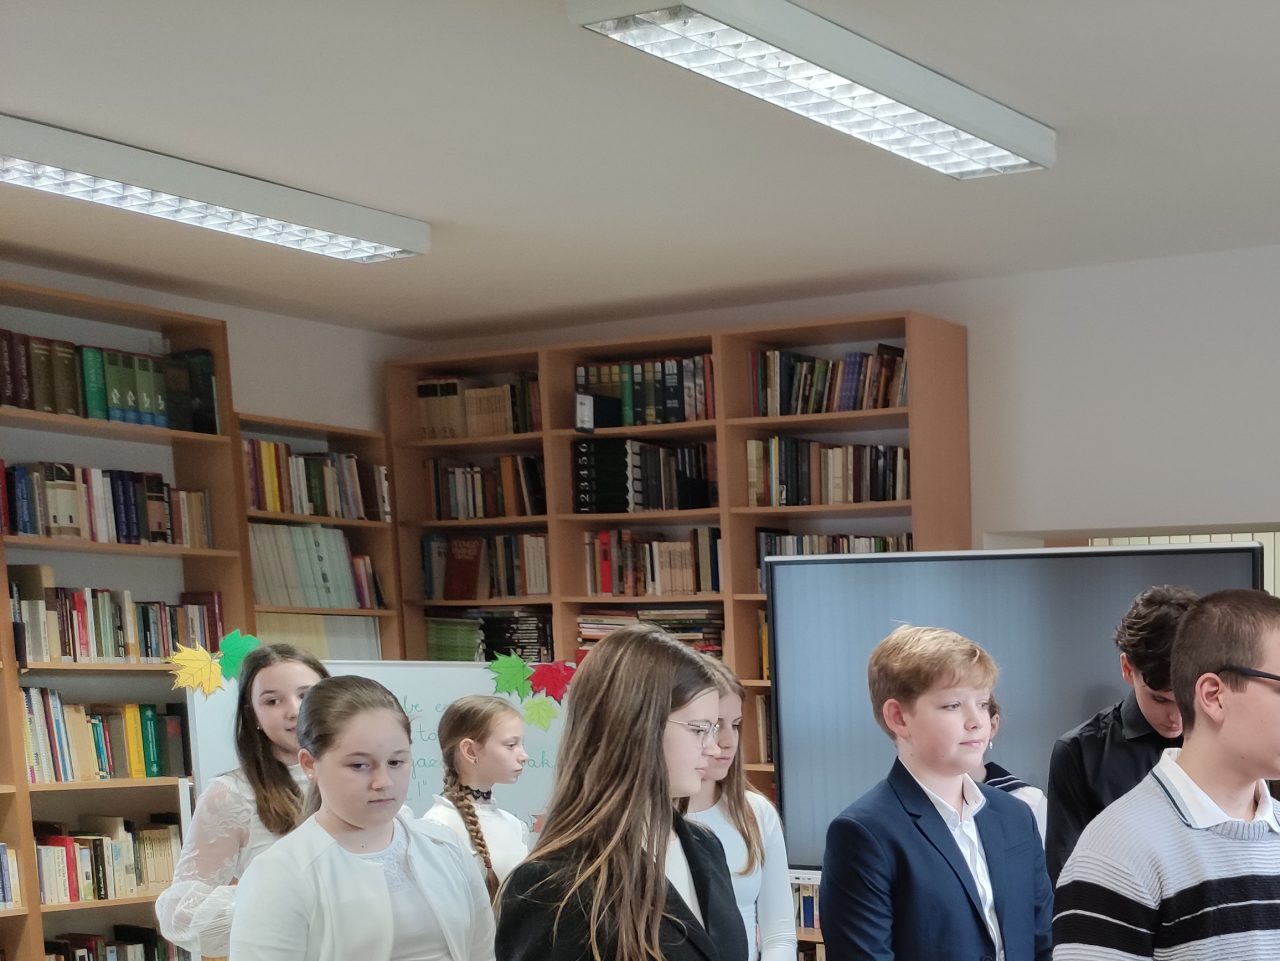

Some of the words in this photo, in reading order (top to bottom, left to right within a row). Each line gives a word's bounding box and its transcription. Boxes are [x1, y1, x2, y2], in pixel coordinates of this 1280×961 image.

[578, 456, 588, 465] 5
[580, 482, 589, 490] 3
[580, 494, 589, 502] 2
